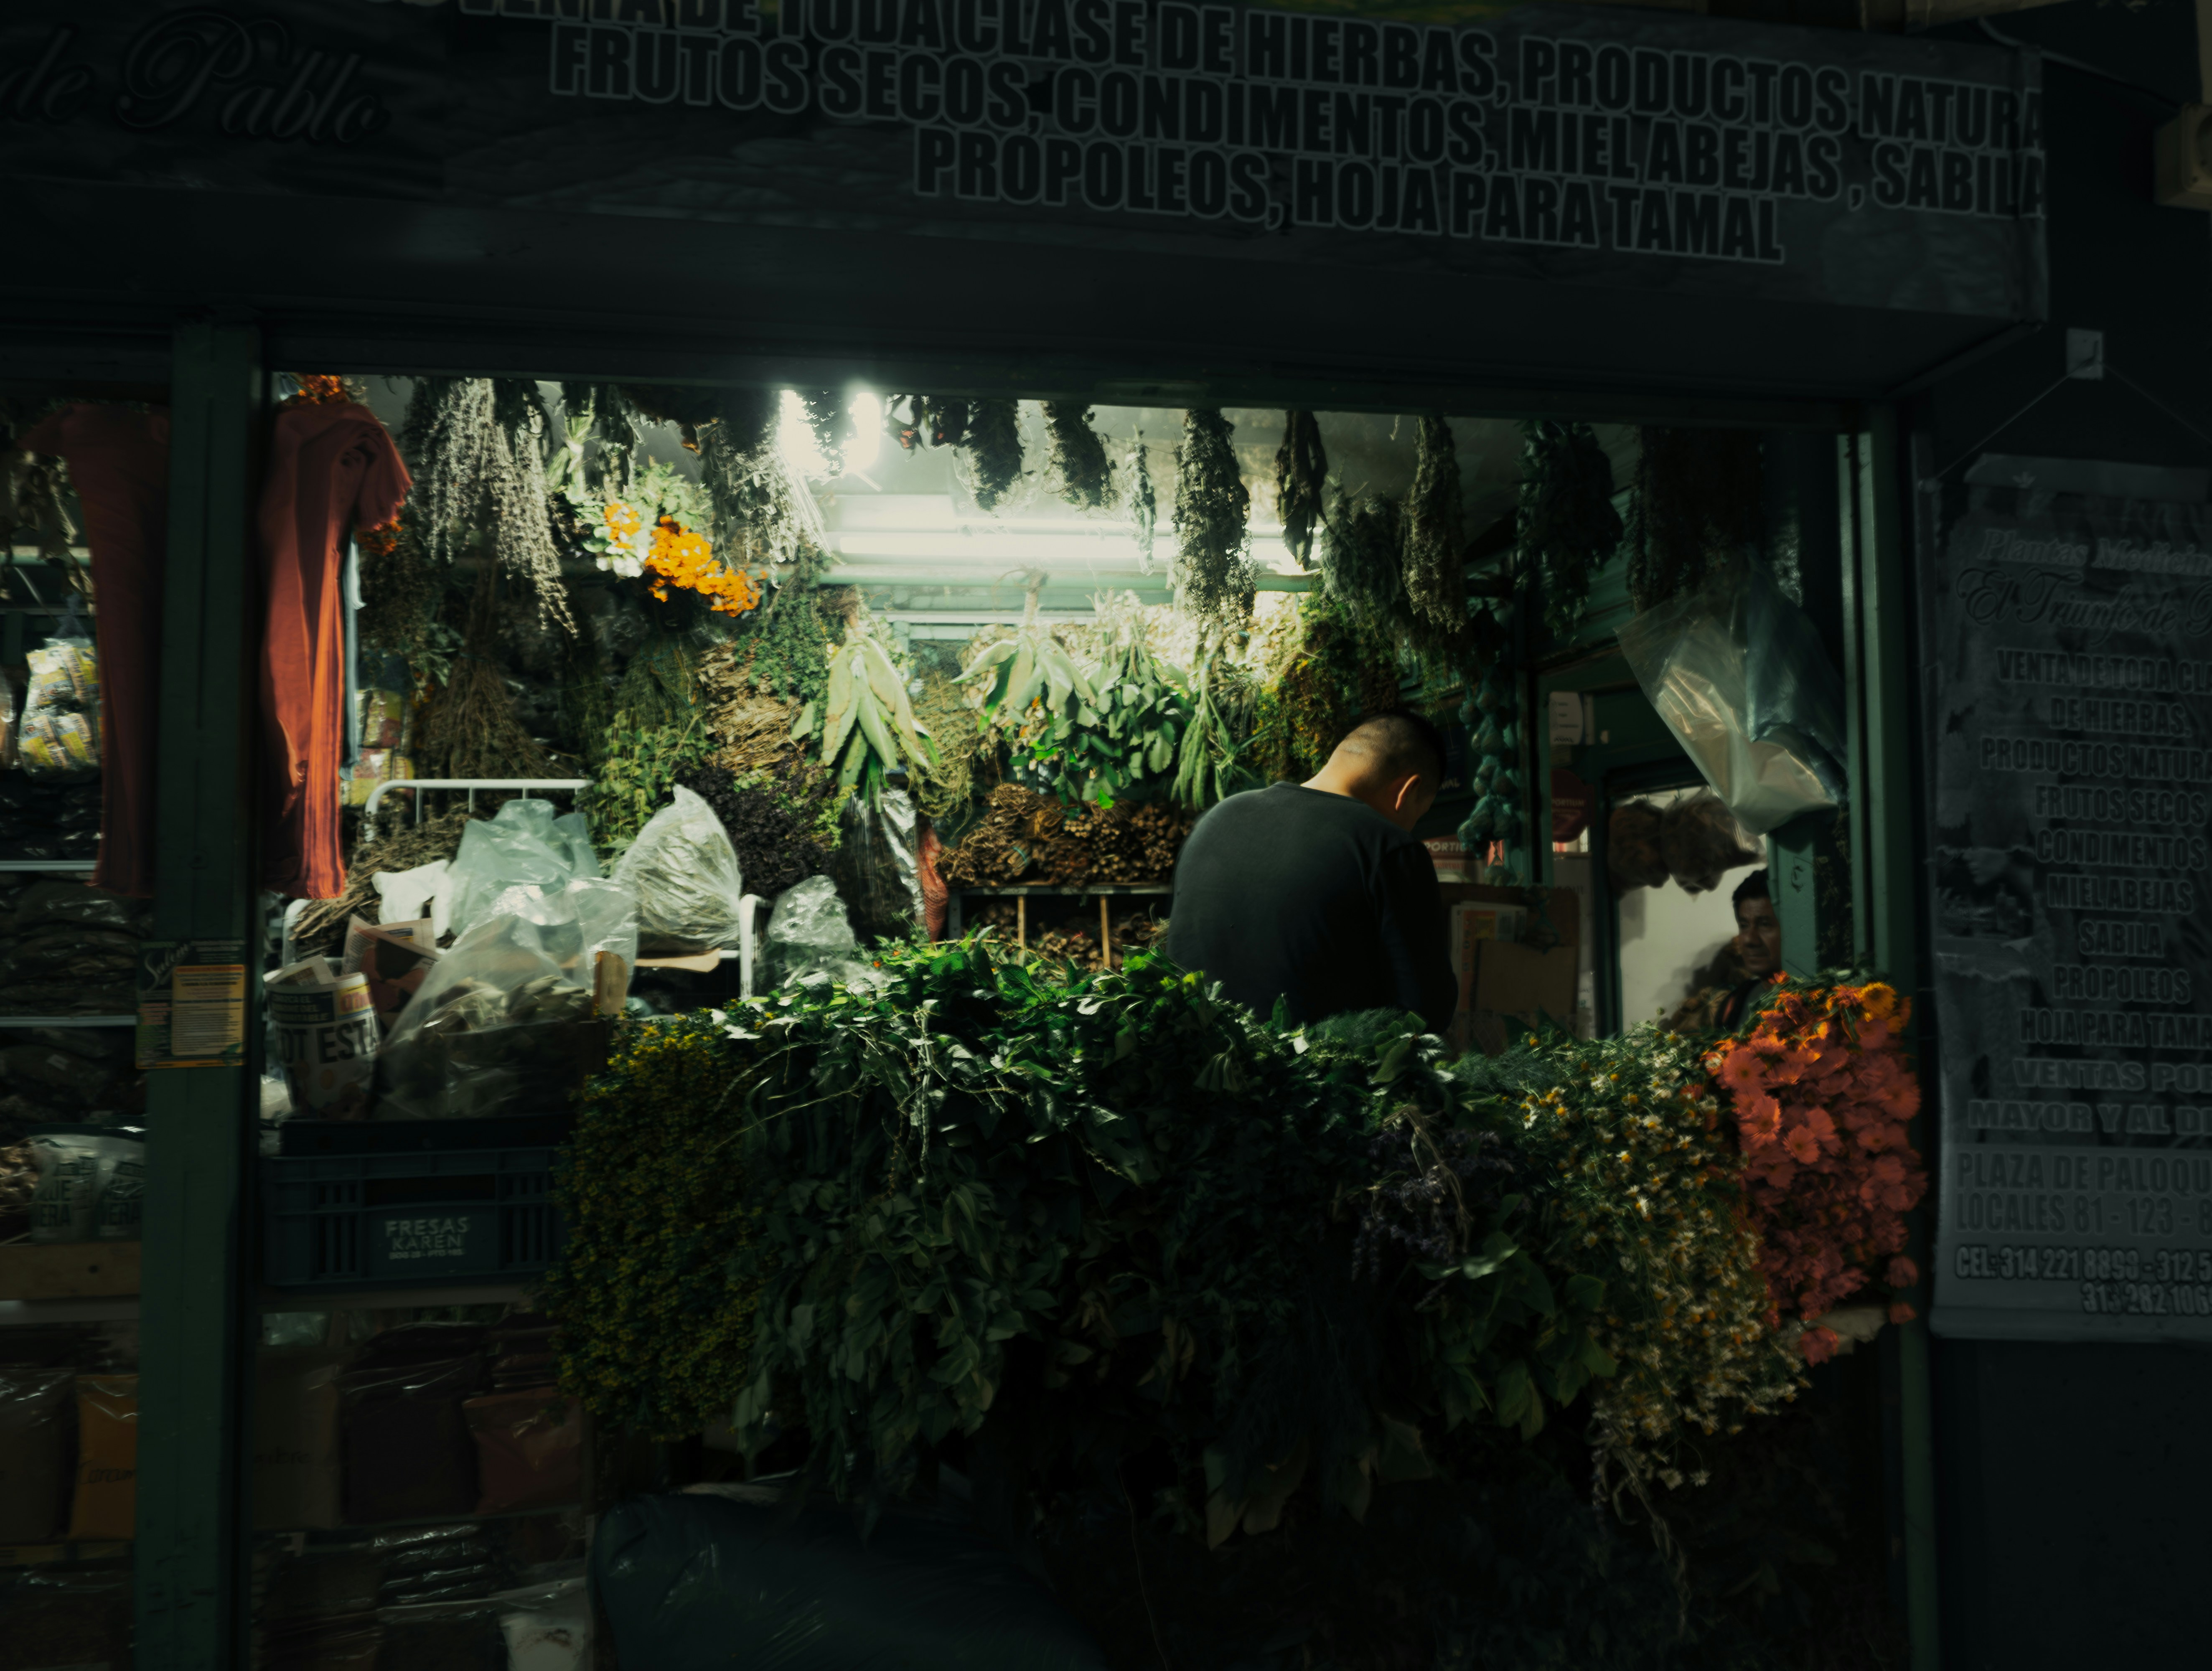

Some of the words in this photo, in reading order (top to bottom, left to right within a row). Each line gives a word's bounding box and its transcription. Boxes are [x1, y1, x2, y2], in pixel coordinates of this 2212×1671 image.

[111, 6, 391, 147] Pablo
[954, 0, 1146, 67] CLASE
[1158, 3, 1234, 77] DE
[1246, 9, 1510, 108] HIERBAS,
[1519, 34, 1851, 135] PRODUCTOS
[549, 21, 809, 115] FRUTOS
[818, 42, 1043, 136] SECOS,
[1053, 66, 1499, 173] CONDIMENTOS,
[1508, 103, 1638, 182] MIEL
[914, 124, 1284, 231] PROPOLEOS,
[1292, 156, 1442, 236] HOJA
[1449, 169, 1599, 249] PARA
[1605, 182, 1785, 265] TAMAL
[1977, 529, 2089, 566] Plantas
[1956, 568, 2014, 625] El
[2016, 567, 2138, 647] Triunfo
[2142, 590, 2178, 634] de
[1996, 647, 2071, 685] VENTA
[2075, 652, 2106, 688] DE
[2108, 655, 2173, 693] TODA
[2049, 696, 2081, 731] DE
[1980, 735, 2126, 777] PRODUCTOS
[2035, 783, 2126, 823] FRUTOS
[2129, 788, 2207, 827] SECOS
[2035, 828, 2207, 871] CONDIMENTOS
[2048, 873, 2105, 909] MIEL
[2106, 876, 2194, 914] ABEJAS
[2078, 919, 2165, 958] SABILA
[2052, 964, 2191, 1004] PROPOLEOS
[2019, 1007, 2080, 1045] HOJA
[2080, 1010, 2147, 1048] PARA
[2013, 1058, 2145, 1092] VENTAS
[1968, 1100, 2093, 1133] MAYOR
[2097, 1103, 2122, 1133] Y
[2126, 1105, 2171, 1134] AL
[1956, 1152, 2045, 1191] PLAZA
[2052, 1154, 2089, 1191] DE
[385, 1216, 471, 1237] FRESAS
[1955, 1191, 2069, 1234] LOCALES
[2072, 1194, 2106, 1236] 81
[2125, 1196, 2176, 1237] 123
[392, 1234, 464, 1251] KAREN
[1999, 1245, 2039, 1280] 314
[2041, 1247, 2080, 1280] 221
[2155, 1248, 2194, 1282] 312
